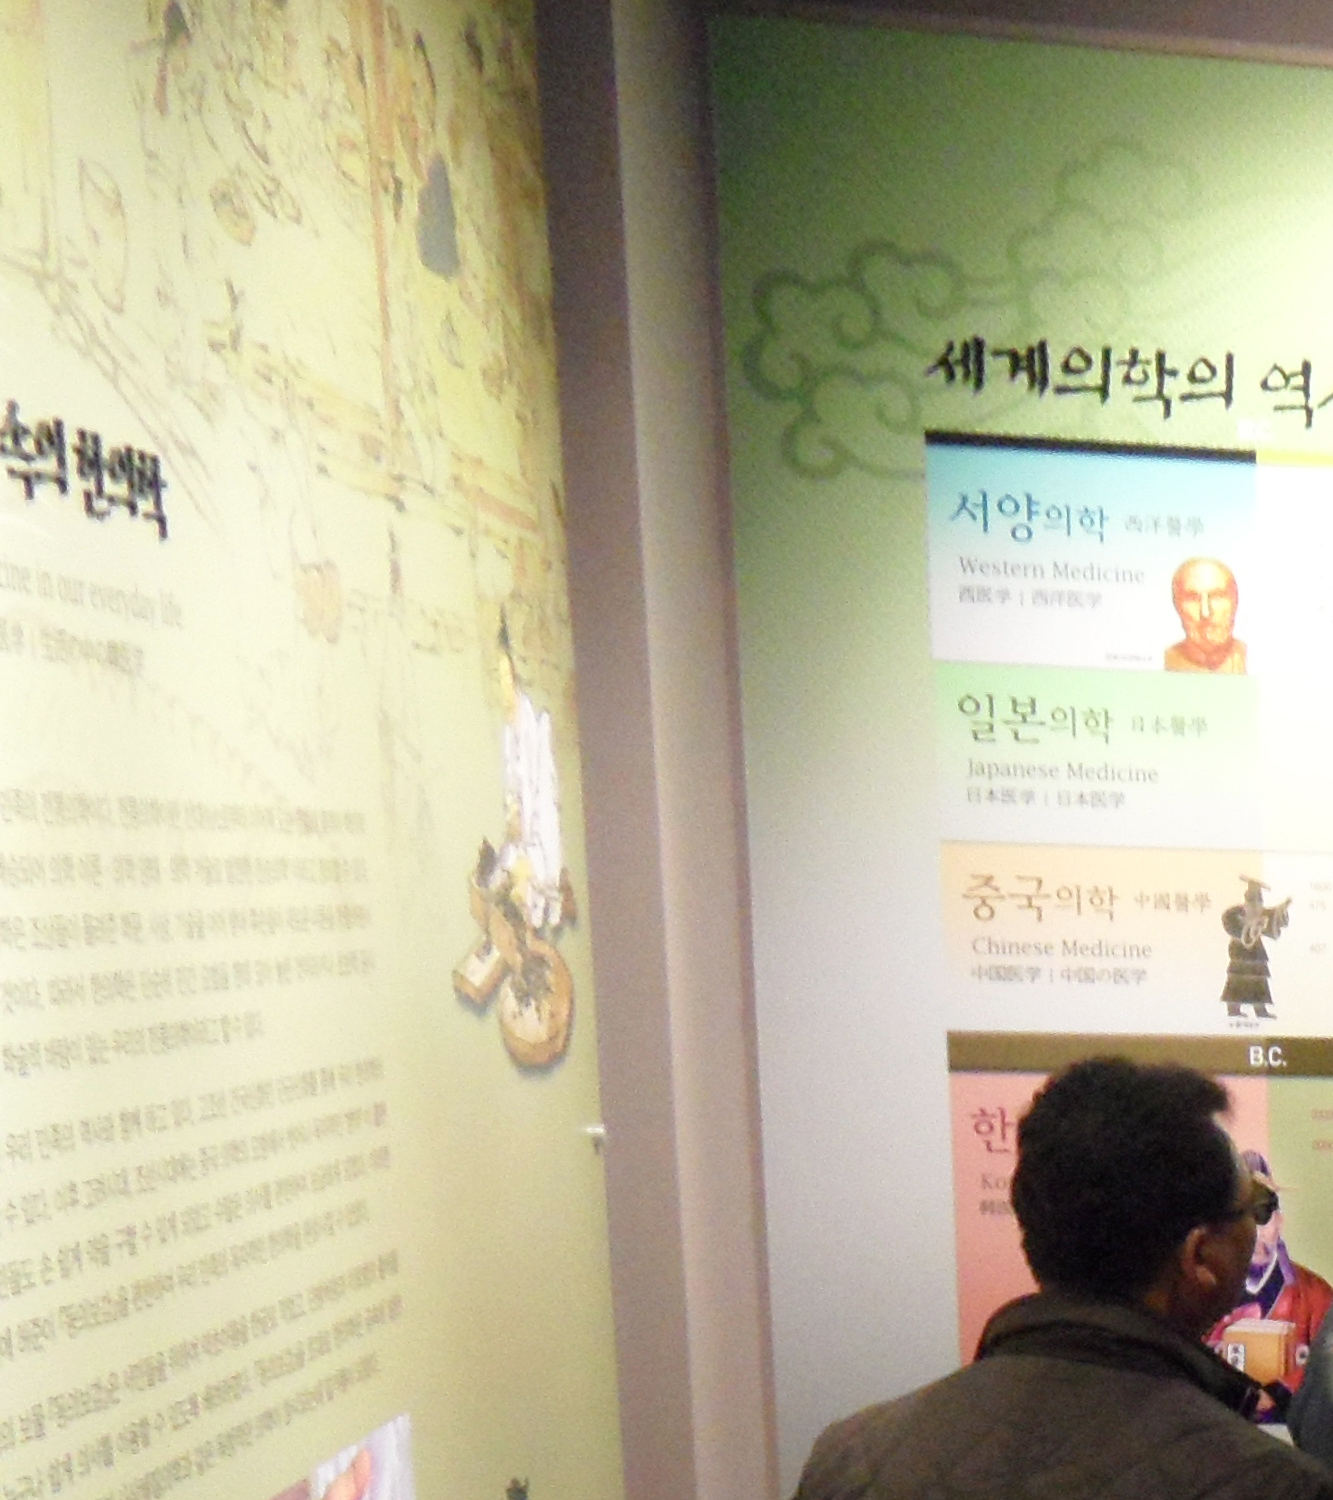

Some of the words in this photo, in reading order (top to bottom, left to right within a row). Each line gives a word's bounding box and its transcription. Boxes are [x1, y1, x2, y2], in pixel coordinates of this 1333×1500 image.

[925, 336, 1235, 420] 세계의학의
[73, 428, 168, 541] 한의학
[951, 489, 1109, 543] 서양의학
[959, 556, 1045, 578] Western
[1052, 561, 1145, 584] Medicine
[957, 694, 1114, 744] 일본의학
[966, 759, 1060, 780] Japanese
[1067, 762, 1159, 783] Medicine
[962, 874, 1120, 923] 중국의학
[972, 937, 1054, 958] Chinese
[1061, 939, 1152, 959] Medicine
[1249, 1045, 1288, 1067] B.C.
[970, 1106, 1016, 1155] 한
